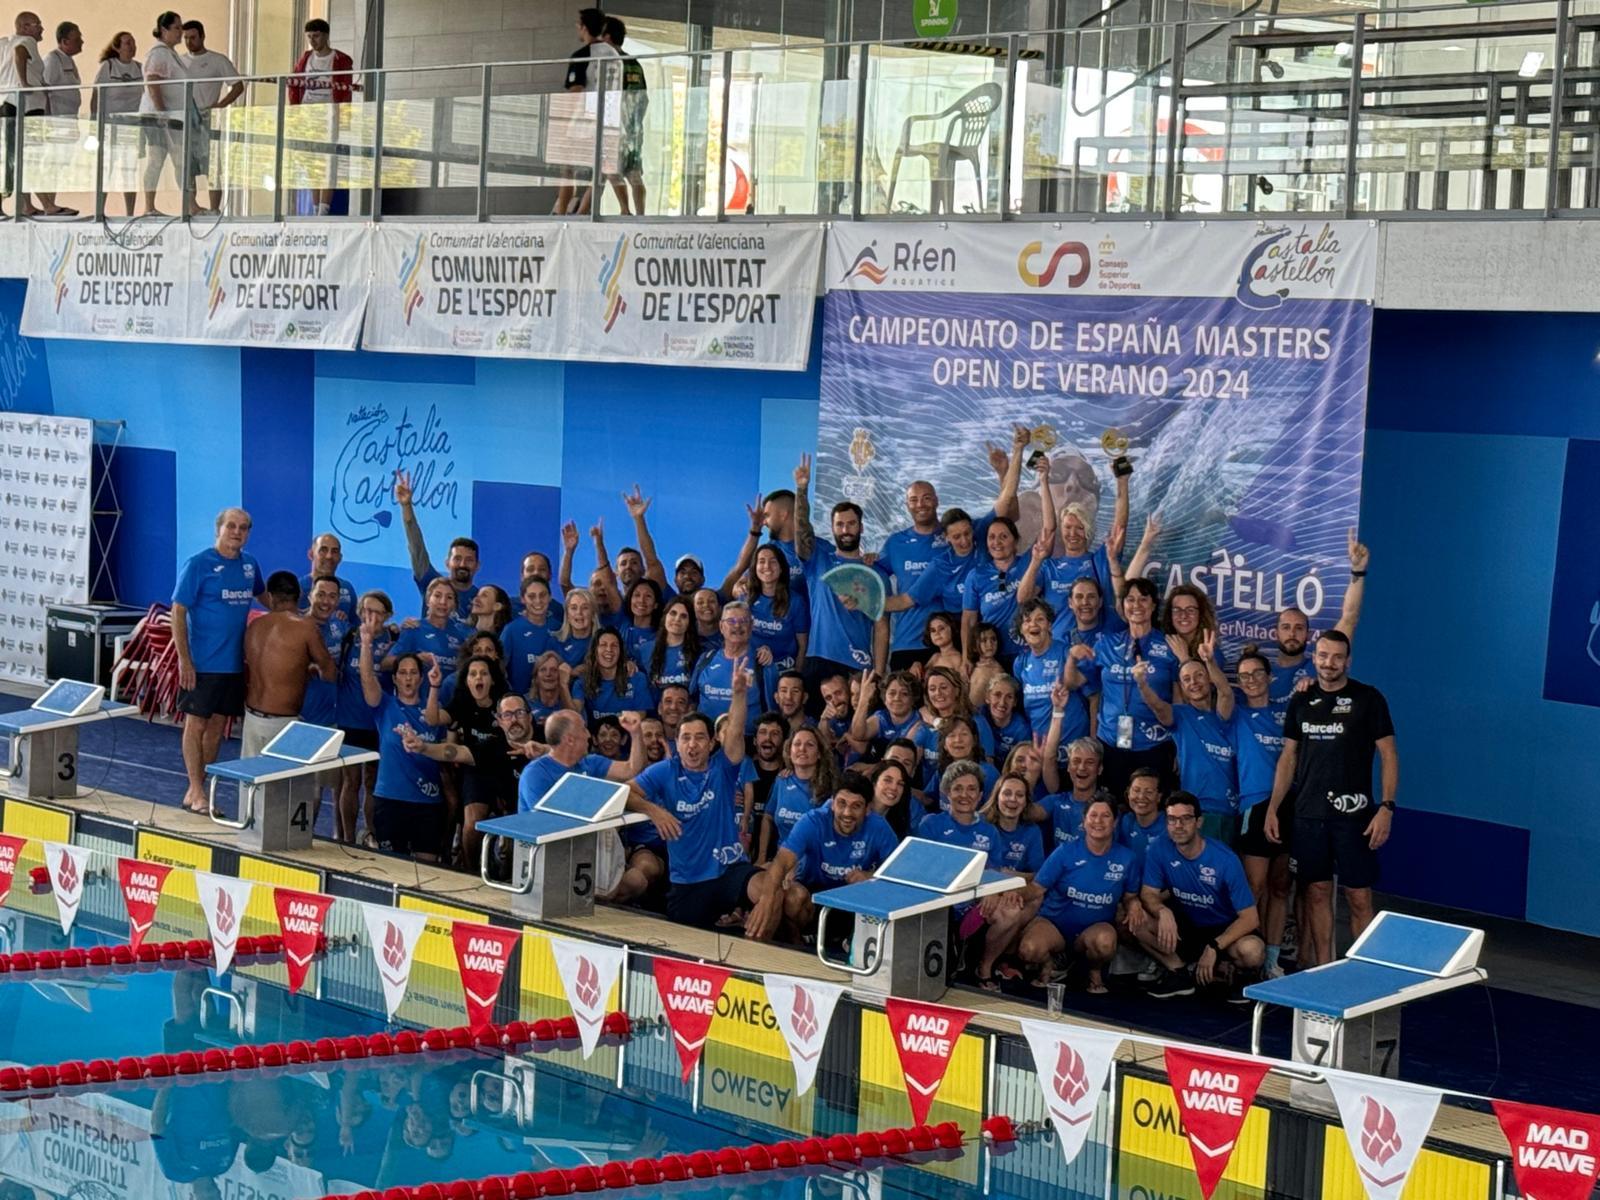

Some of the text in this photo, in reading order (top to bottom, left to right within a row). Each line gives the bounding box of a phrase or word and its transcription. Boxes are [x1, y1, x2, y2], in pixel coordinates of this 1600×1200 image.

[230, 232, 279, 247] Comunitat
[430, 232, 545, 248] Comunitat Valenciana
[633, 233, 765, 250] Comunitat Valenciana
[76, 252, 163, 277] COMUNITAT
[230, 254, 327, 279] COMUNITAT
[893, 239, 956, 272] Rfen
[431, 255, 545, 283] COMUNITAT
[634, 257, 766, 288] COMUNITAT
[79, 280, 173, 306] DE L'ESPORT
[235, 284, 340, 311] DE L'ESPORT
[437, 287, 557, 317] DE L'ESPORT
[642, 292, 781, 324] DE L'ESPORT
[848, 315, 1331, 361] CAMPEONATO DE ESPAÑA MASTERS
[933, 357, 1250, 400] OPEN DE VERANO 2024
[904, 560, 929, 571] Barc
[221, 589, 253, 599] Barcel
[751, 615, 783, 631] arceló
[704, 685, 733, 696] Barce
[1301, 722, 1344, 733] Barceló
[57, 752, 75, 781] 3
[290, 801, 310, 832] 4
[778, 807, 803, 820] Barc
[130, 871, 158, 887] MAD
[573, 863, 592, 896] 5
[125, 886, 160, 905] WAVE
[1066, 886, 1113, 904] Barceló
[288, 901, 318, 920] MAD
[284, 916, 320, 936] WAVE
[468, 937, 503, 956] MAD
[923, 940, 943, 977] 6
[463, 953, 505, 975] WAVE
[673, 975, 712, 997] MAD
[666, 993, 716, 1015] WAVE
[715, 992, 780, 1031] OMEG
[906, 1014, 950, 1036] MAD
[900, 1032, 951, 1058] WAVE
[1307, 1037, 1330, 1076] 7
[1375, 1039, 1397, 1078] 7
[1188, 1068, 1240, 1094] MAD
[1181, 1089, 1244, 1116] WAVE
[1526, 1121, 1590, 1151] MAD
[1518, 1145, 1596, 1177] WAVE
